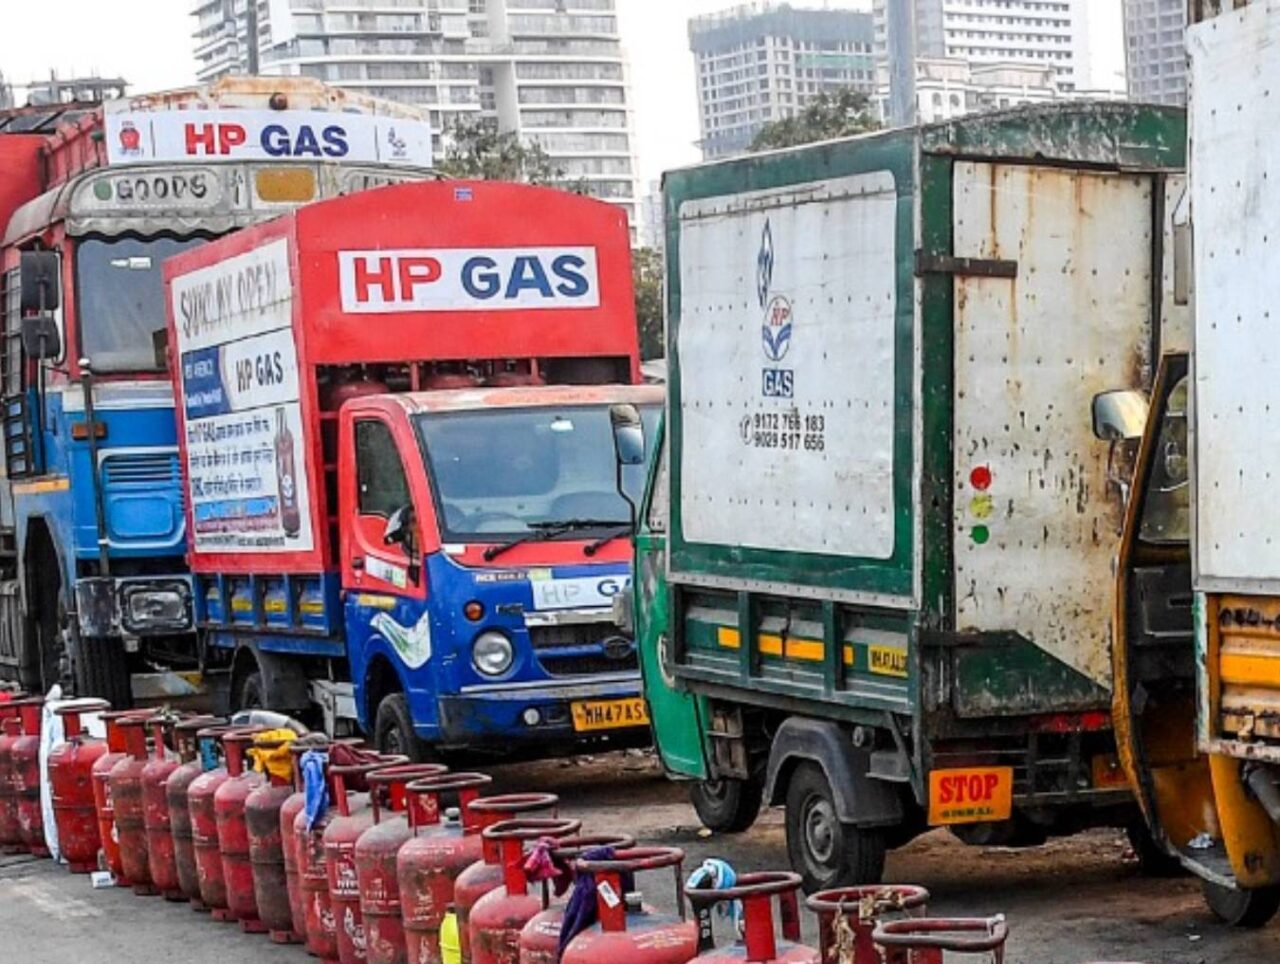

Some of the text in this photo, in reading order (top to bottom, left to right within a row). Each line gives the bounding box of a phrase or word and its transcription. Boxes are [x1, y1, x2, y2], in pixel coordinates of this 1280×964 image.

[184, 123, 350, 157] HP GAS
[116, 174, 209, 201] GOODS
[353, 254, 590, 303] HP GAS
[235, 357, 253, 393] HP
[255, 351, 285, 387] GAS
[763, 370, 792, 396] GAS
[939, 773, 999, 804] STOP
